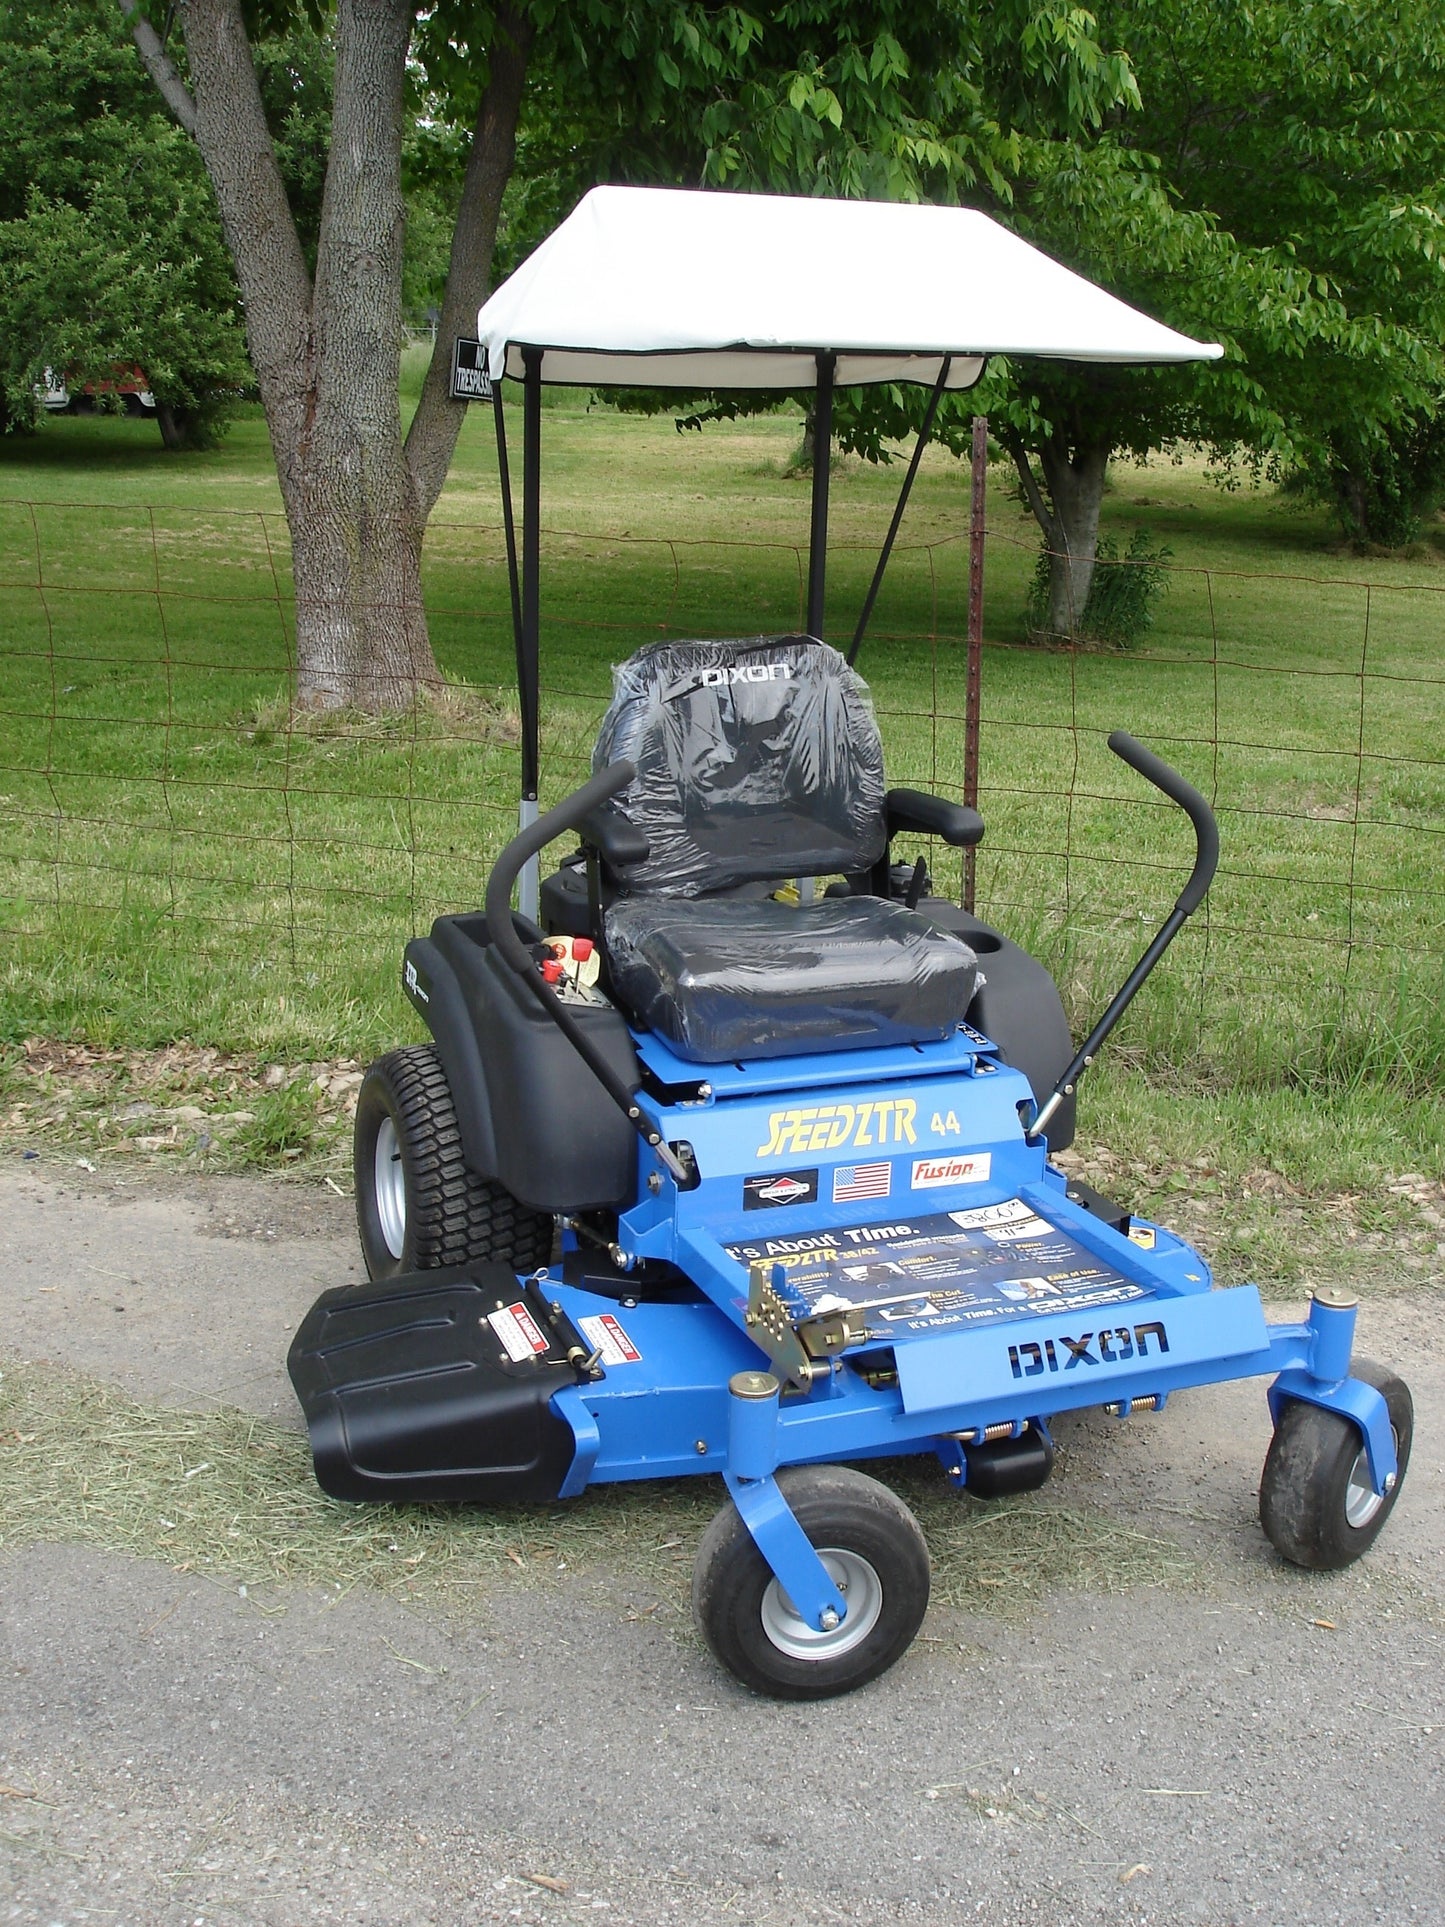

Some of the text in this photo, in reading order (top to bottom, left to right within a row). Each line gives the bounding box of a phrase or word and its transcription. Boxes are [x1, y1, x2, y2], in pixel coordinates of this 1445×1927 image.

[475, 345, 486, 369] NO
[702, 663, 790, 686] DIXON
[756, 1098, 961, 1157] SPEEDZTR 44
[915, 1160, 973, 1180] Fusion
[765, 1233, 842, 1255] About
[843, 1225, 920, 1243] Time.
[929, 1314, 963, 1326] About
[1007, 1321, 1170, 1379] DIXON
